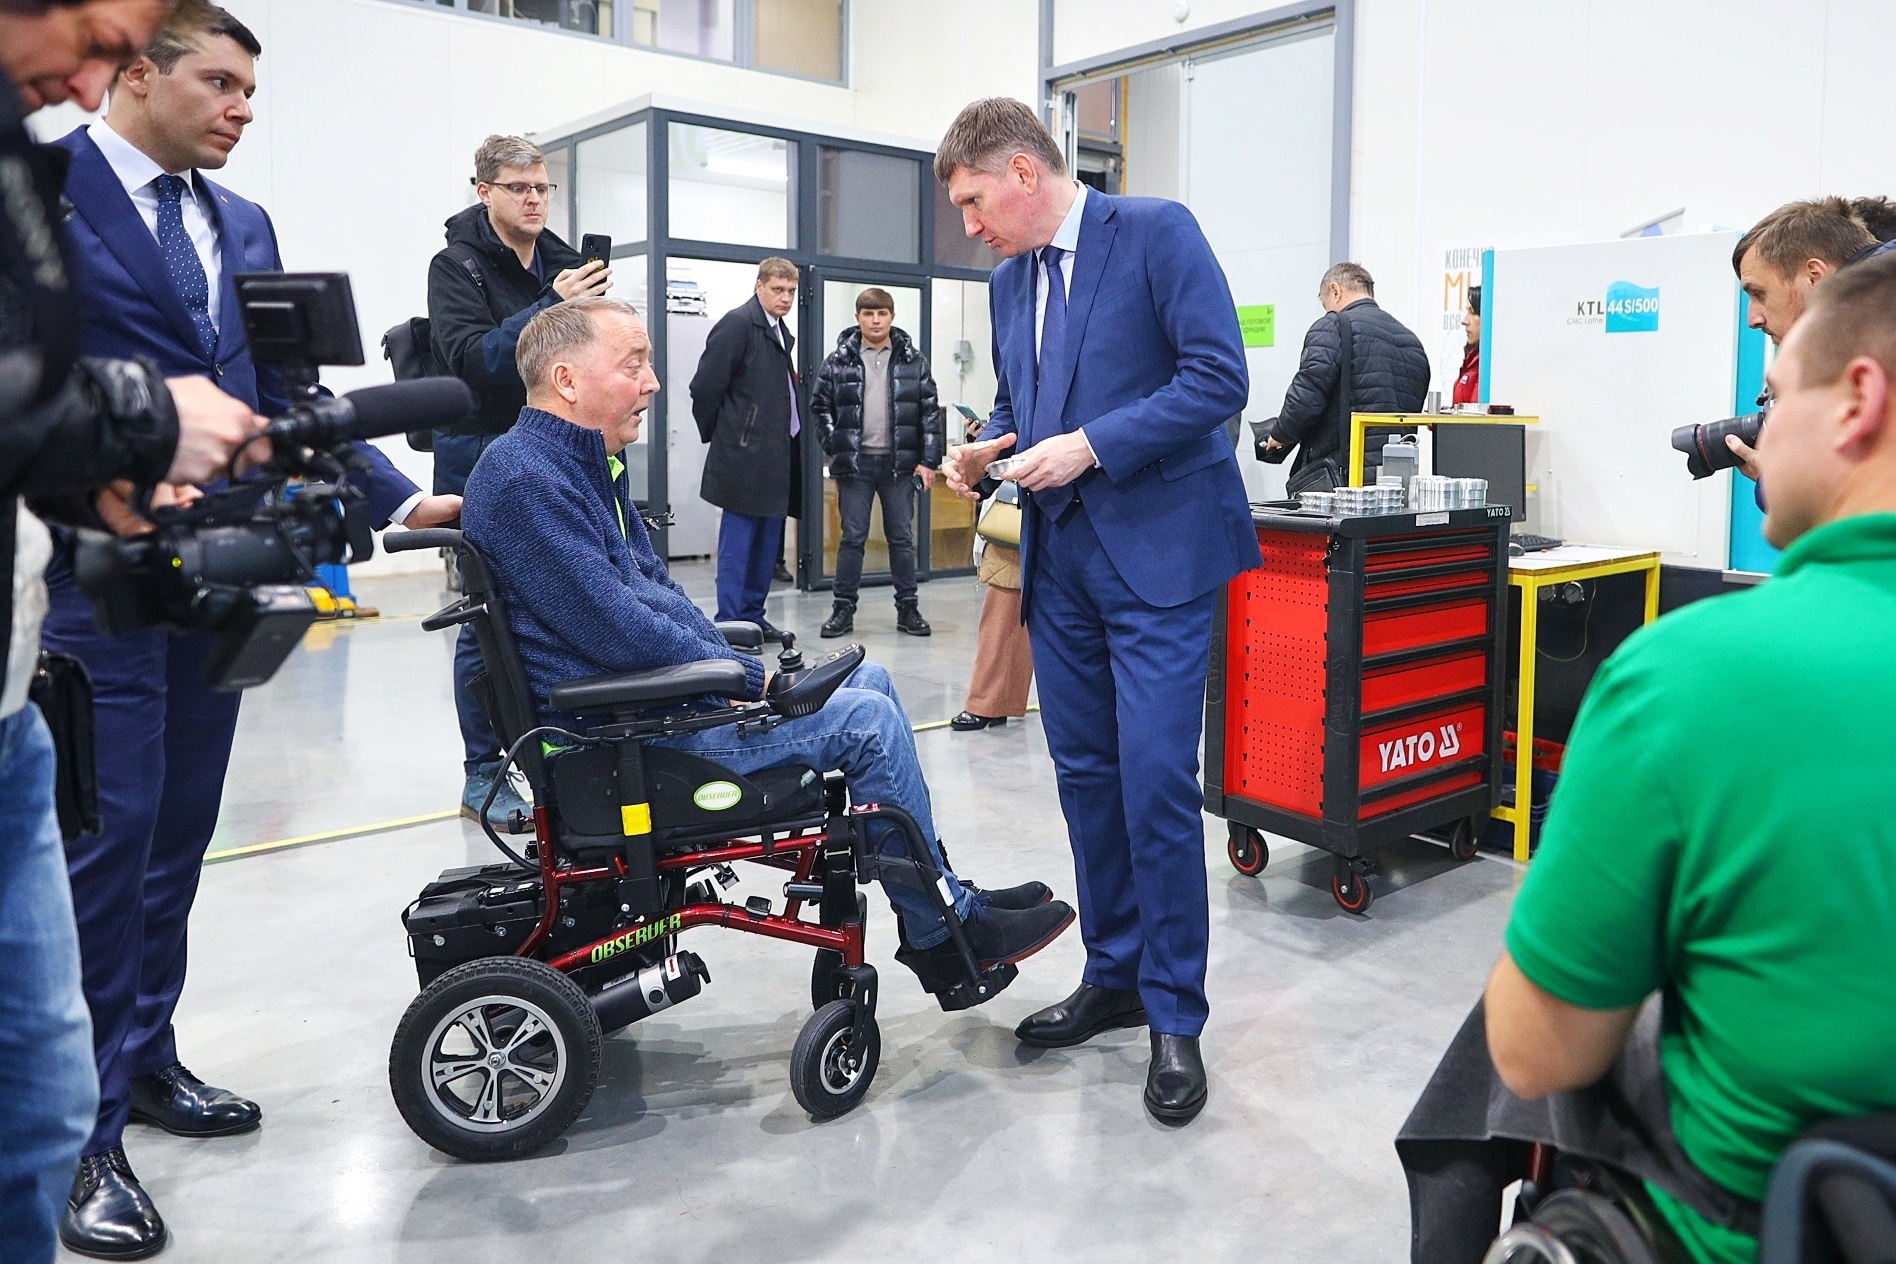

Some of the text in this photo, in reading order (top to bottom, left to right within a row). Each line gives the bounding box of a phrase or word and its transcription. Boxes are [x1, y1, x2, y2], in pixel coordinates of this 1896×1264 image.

[1577, 301, 1604, 316] KTL
[1566, 317, 1583, 325] CNC
[1486, 508, 1504, 518] YATO
[1379, 731, 1436, 773] YATO
